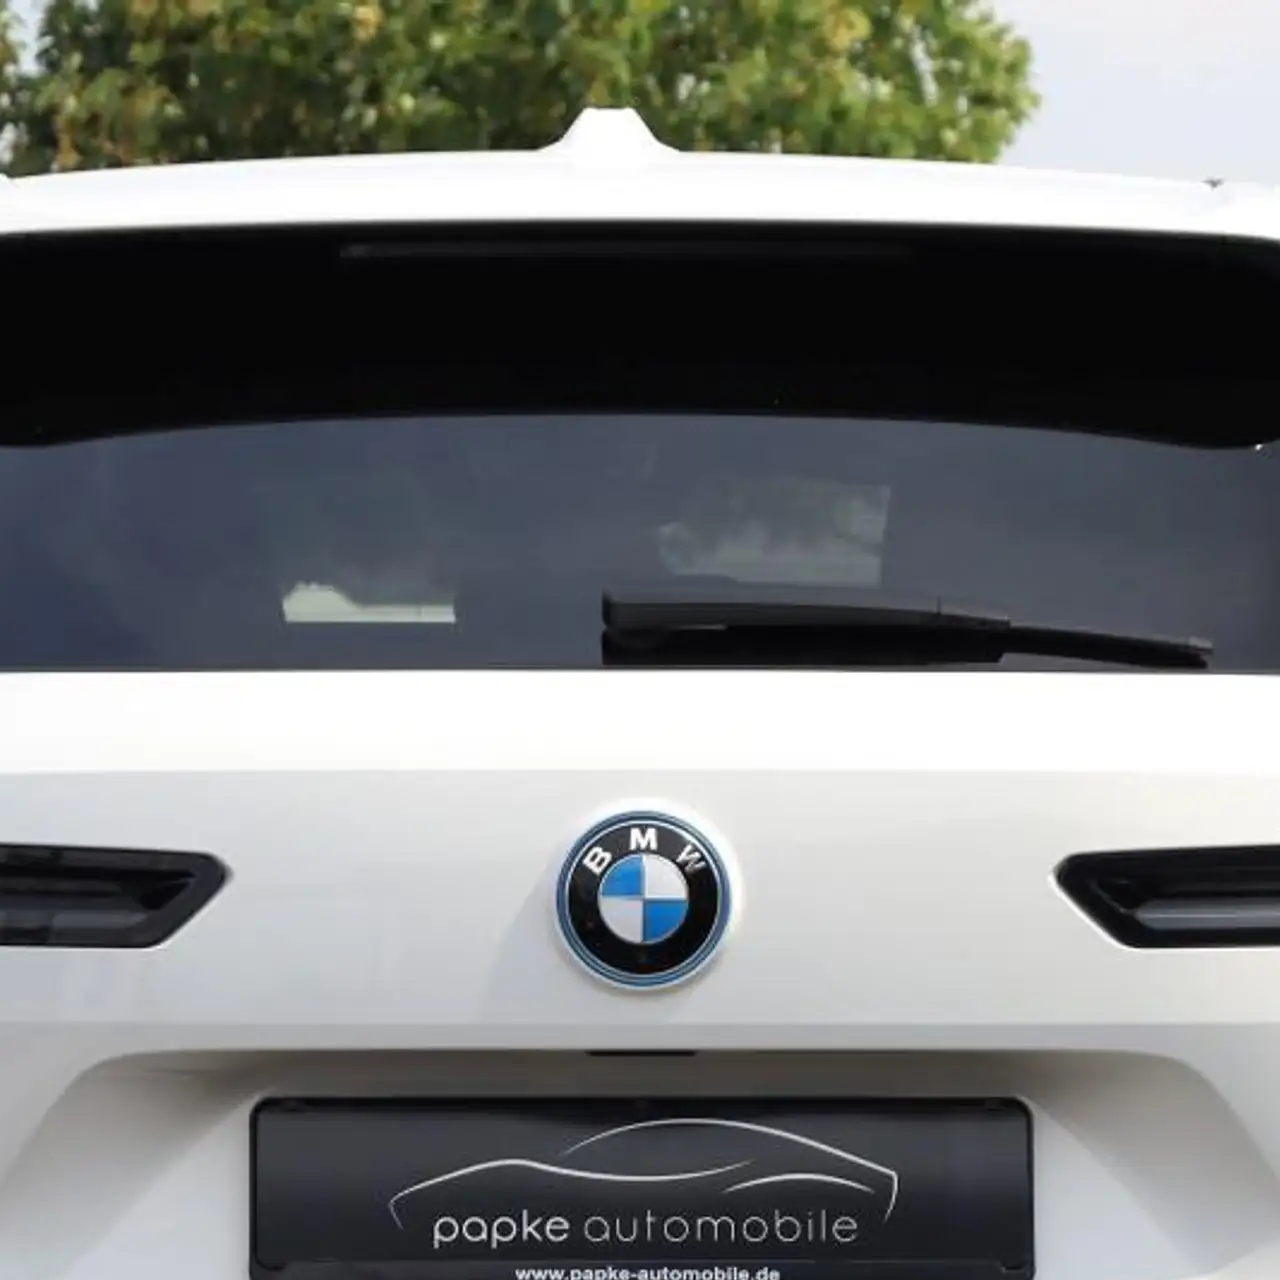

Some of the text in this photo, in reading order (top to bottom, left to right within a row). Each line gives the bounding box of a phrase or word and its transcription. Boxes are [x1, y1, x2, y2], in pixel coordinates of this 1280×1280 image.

[582, 827, 708, 875] BMW
[433, 1209, 858, 1249] papke automobile
